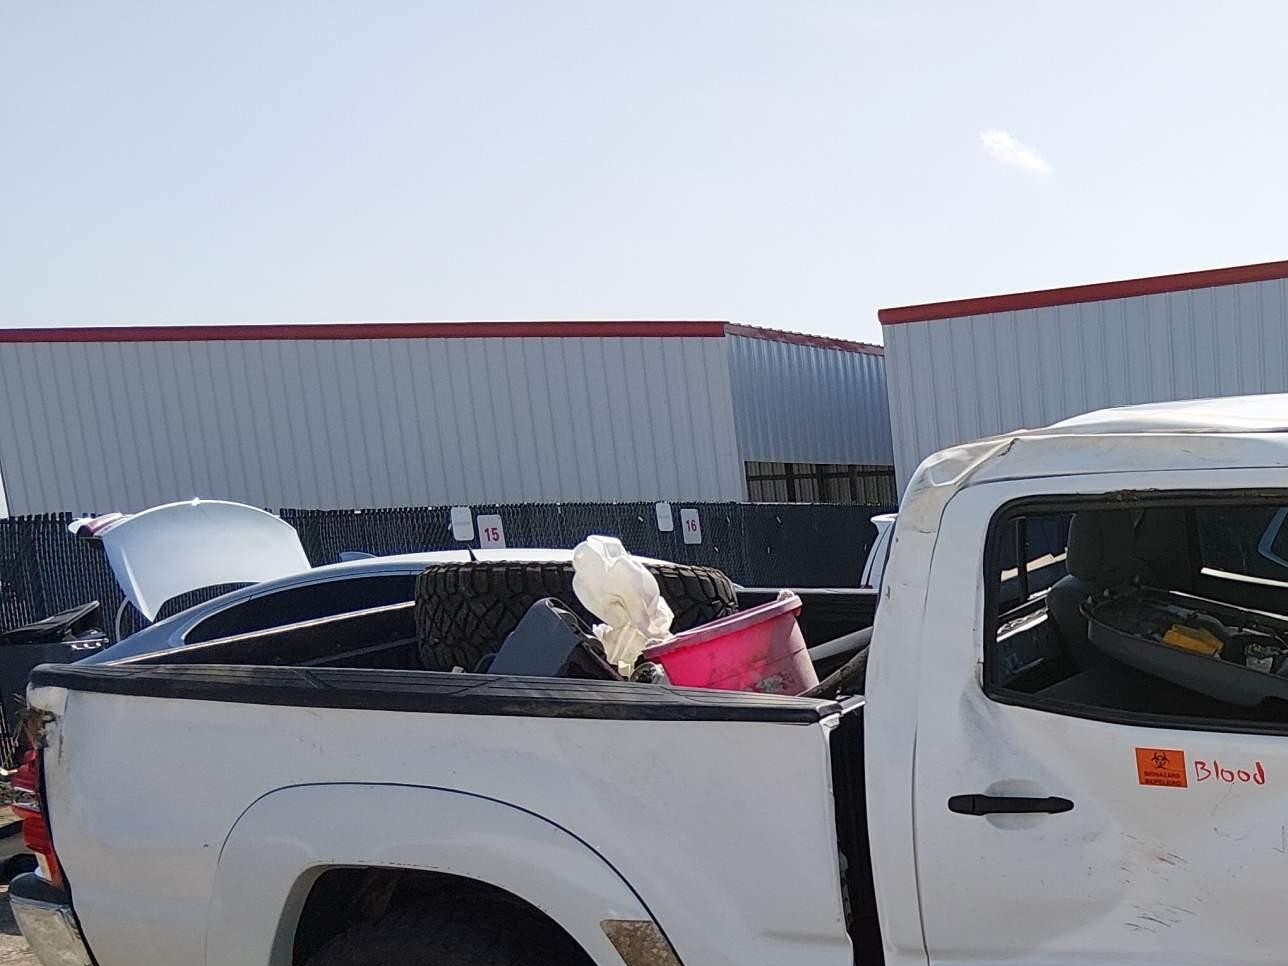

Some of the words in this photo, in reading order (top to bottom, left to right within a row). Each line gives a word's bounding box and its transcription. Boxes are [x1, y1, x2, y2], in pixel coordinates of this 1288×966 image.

[686, 520, 697, 532] 16
[484, 527, 500, 542] 15
[1194, 760, 1265, 785] Blood
